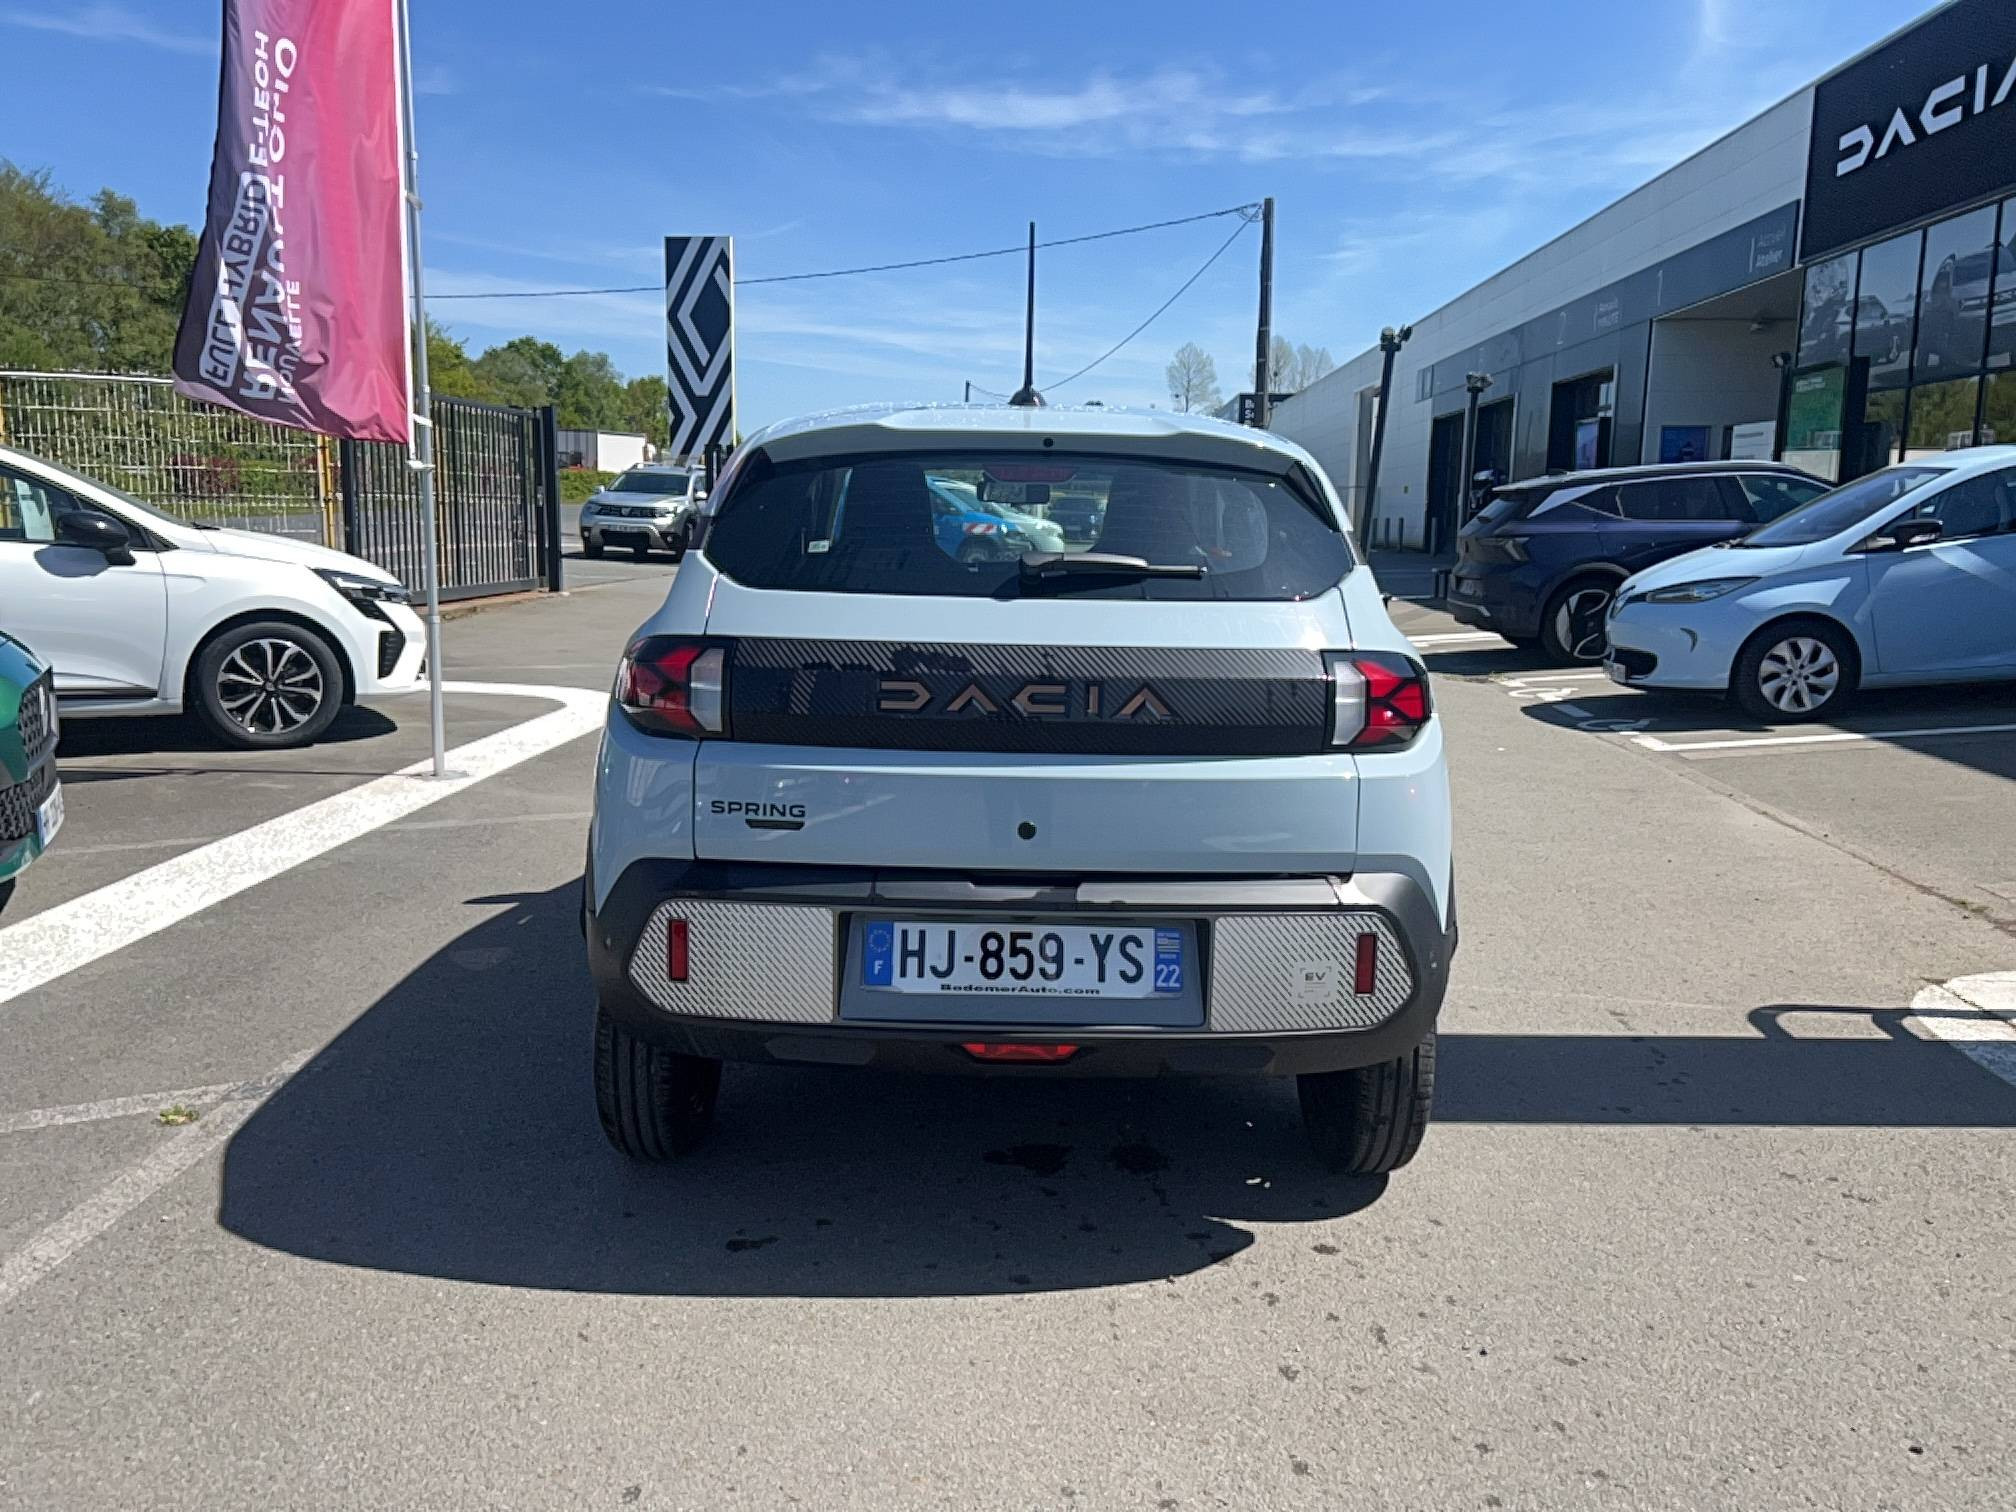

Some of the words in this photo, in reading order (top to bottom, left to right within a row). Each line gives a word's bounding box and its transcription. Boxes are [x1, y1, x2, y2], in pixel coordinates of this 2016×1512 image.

[879, 680, 1171, 718] DACIA
[711, 800, 806, 817] SPRING
[900, 929, 1145, 984] HJ-859-YS
[874, 960, 882, 974] F
[1156, 964, 1180, 988] 22
[1305, 972, 1326, 981] EV
